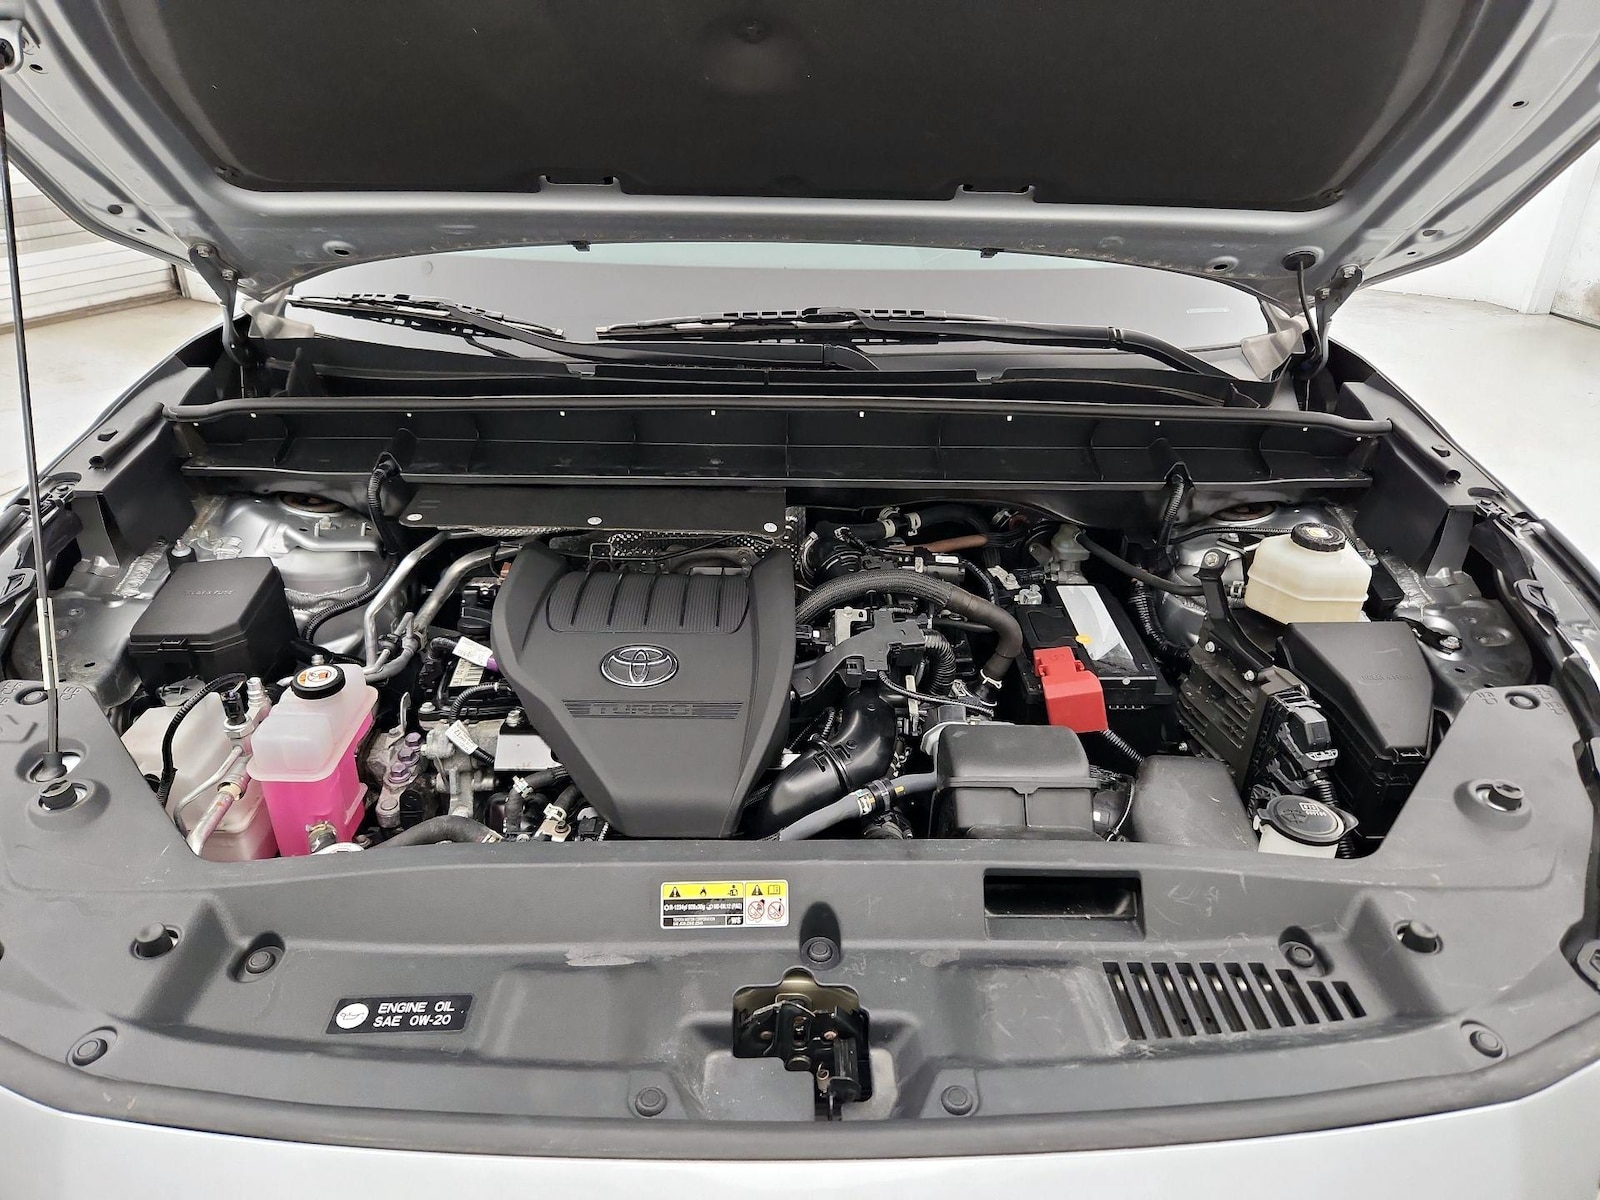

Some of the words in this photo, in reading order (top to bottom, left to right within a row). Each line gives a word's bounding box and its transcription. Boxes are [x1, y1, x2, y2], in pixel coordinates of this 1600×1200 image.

[593, 702, 690, 715] TURBO
[378, 1002, 428, 1014] ENGINE
[434, 1001, 455, 1012] OIL
[373, 1015, 402, 1027] SAE
[409, 1014, 452, 1026] 0W-20
